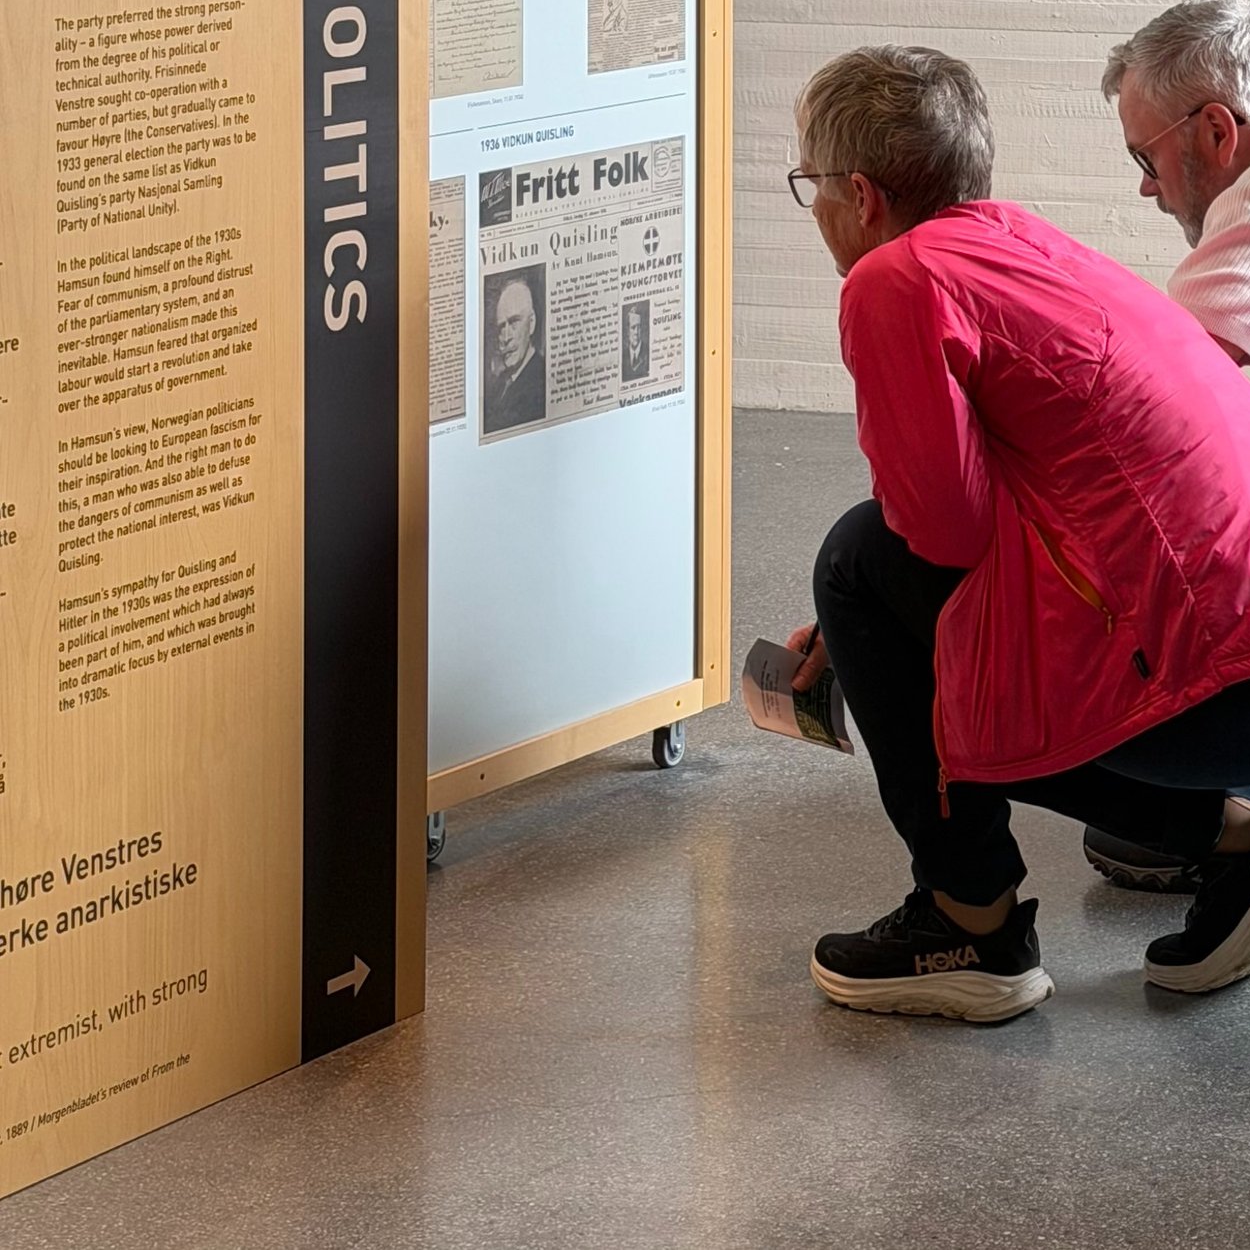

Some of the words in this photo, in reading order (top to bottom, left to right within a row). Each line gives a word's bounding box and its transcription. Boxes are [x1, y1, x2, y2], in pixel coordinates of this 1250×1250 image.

[55, 97, 95, 112] Venstre
[97, 90, 132, 107] sought
[134, 82, 197, 101] co-operation
[199, 77, 220, 91] with
[222, 79, 228, 89] a
[481, 137, 501, 152] 1936
[502, 133, 534, 149] VIDKUN
[536, 125, 574, 143] QUISLING
[56, 176, 86, 192] found
[88, 177, 101, 187] on
[103, 172, 120, 185] the
[122, 169, 150, 182] same
[152, 164, 167, 177] list
[170, 163, 181, 174] as
[183, 157, 216, 171] Vidkun
[56, 194, 107, 212] Quisling's
[109, 189, 136, 207] party
[138, 180, 181, 199] Nasjonal
[183, 175, 223, 191] Samling
[516, 163, 580, 207] Fritt
[593, 151, 650, 191] Folk
[429, 211, 449, 230] ky.
[480, 241, 539, 266] Vidkun
[550, 224, 618, 256] Quisling
[621, 253, 682, 277] KJEMPEMØTE
[57, 277, 100, 293] Hamsun
[102, 267, 131, 284] found
[133, 260, 171, 278] himself
[173, 260, 185, 270] on
[187, 255, 203, 267] the
[205, 249, 235, 265] Right.
[621, 269, 682, 292] YOUNGSTORVET
[58, 399, 81, 413] over
[83, 394, 100, 407] the
[102, 384, 153, 404] apparatus
[155, 377, 165, 391] of
[167, 365, 228, 391] government.
[58, 440, 68, 453] In
[71, 428, 121, 449] Hamsun's
[123, 424, 149, 437] view,
[151, 410, 204, 430] Norwegian
[206, 398, 254, 420] politicians
[59, 615, 88, 632] Hitler
[90, 610, 100, 623] in
[102, 606, 119, 619] the
[122, 596, 151, 613] 1930s
[152, 591, 172, 604] was
[174, 586, 190, 598] the
[192, 571, 244, 593] expression
[246, 563, 255, 578] of
[59, 698, 75, 712] the
[79, 687, 112, 705] 1930s.
[61, 831, 163, 885] Venstres
[56, 862, 198, 934] anarkistiske
[915, 945, 980, 974] HOKA
[9, 1009, 103, 1065] extremist,
[108, 990, 146, 1023] with
[152, 969, 208, 1006] strong
[6, 1120, 28, 1141] 1889
[37, 1088, 108, 1128] Morgenbladet's
[108, 1076, 139, 1095] review
[141, 1068, 151, 1083] of
[151, 1060, 175, 1079] From
[176, 1053, 191, 1067] the
